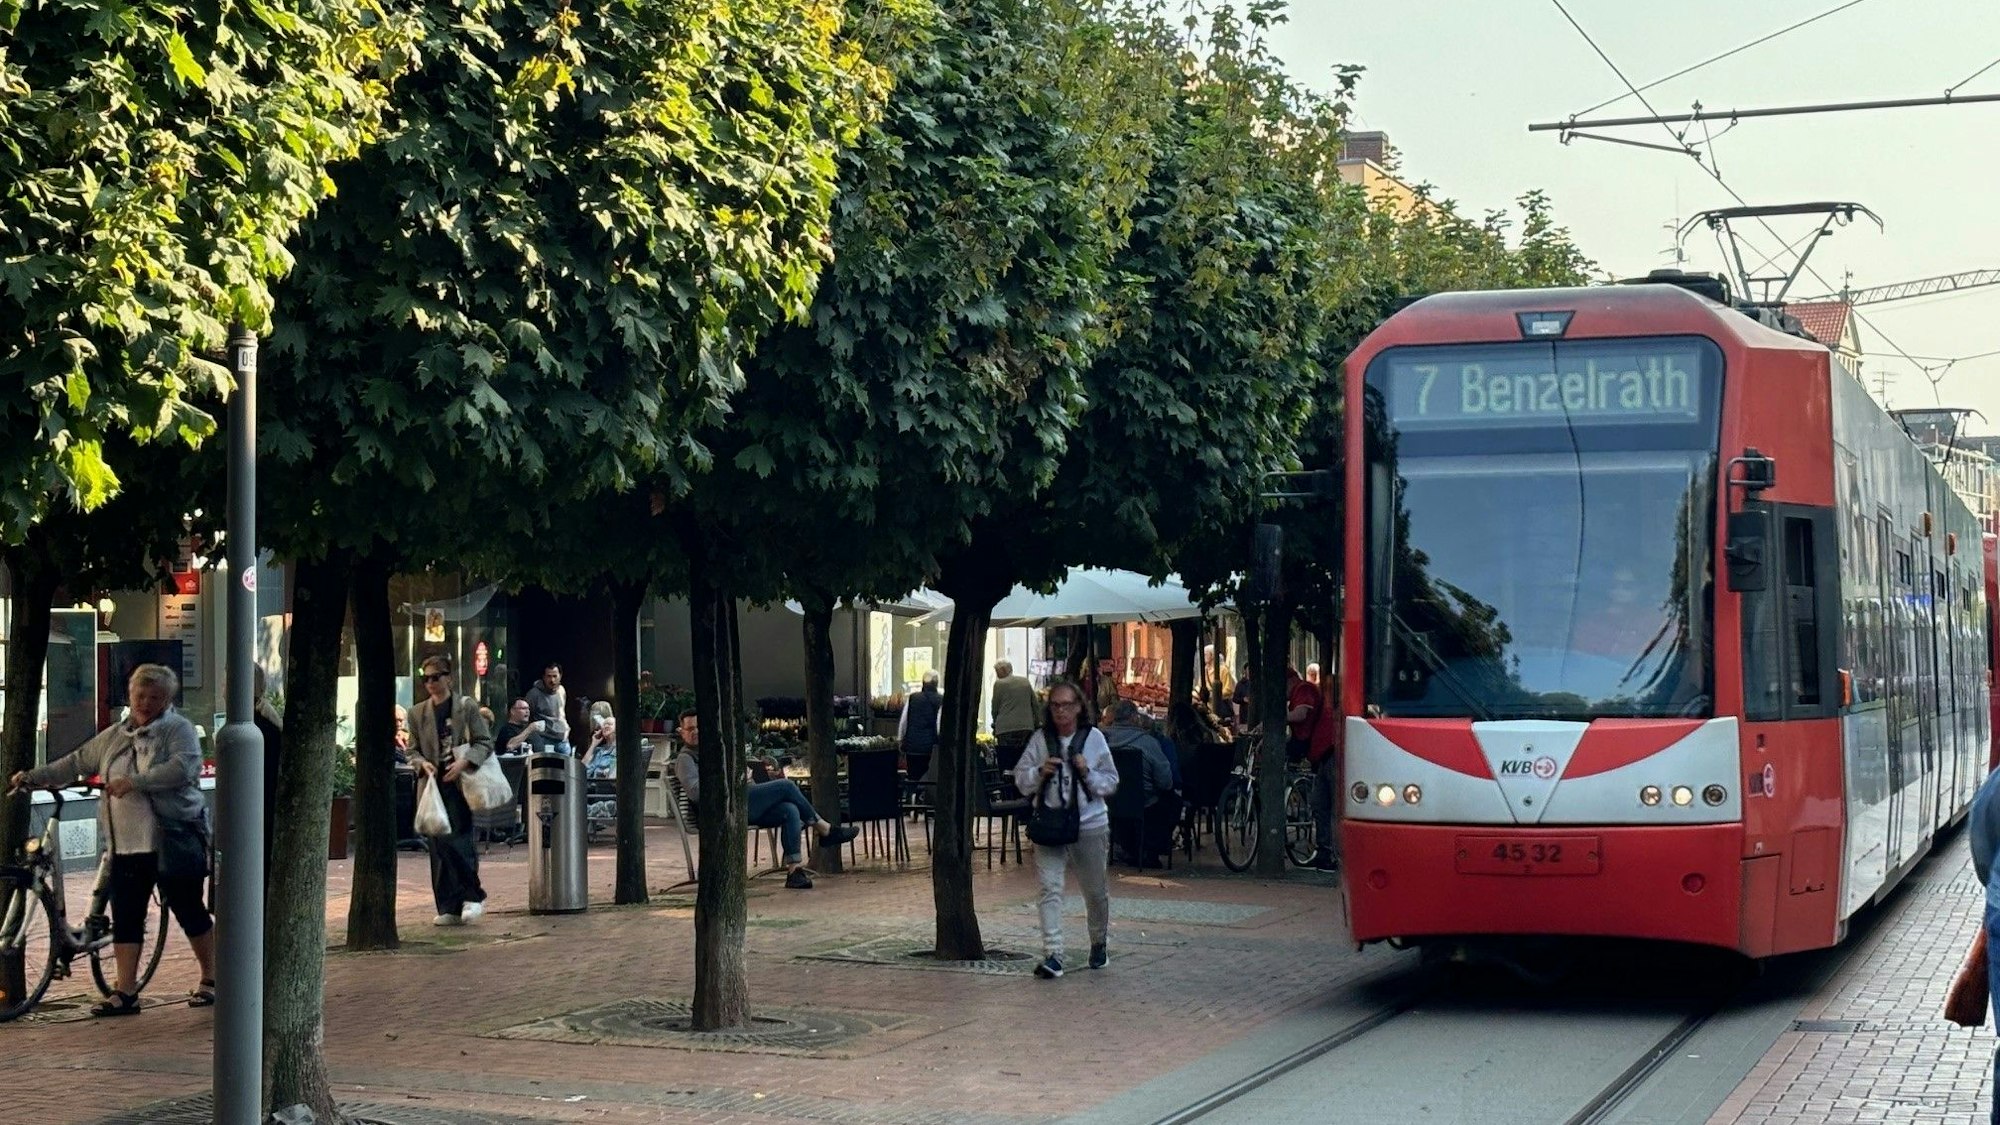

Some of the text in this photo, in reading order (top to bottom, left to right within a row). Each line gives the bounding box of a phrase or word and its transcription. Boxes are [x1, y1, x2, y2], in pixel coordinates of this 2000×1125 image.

[1412, 357, 1687, 416] 7 Benzelrath
[1501, 760, 1533, 774] KVB
